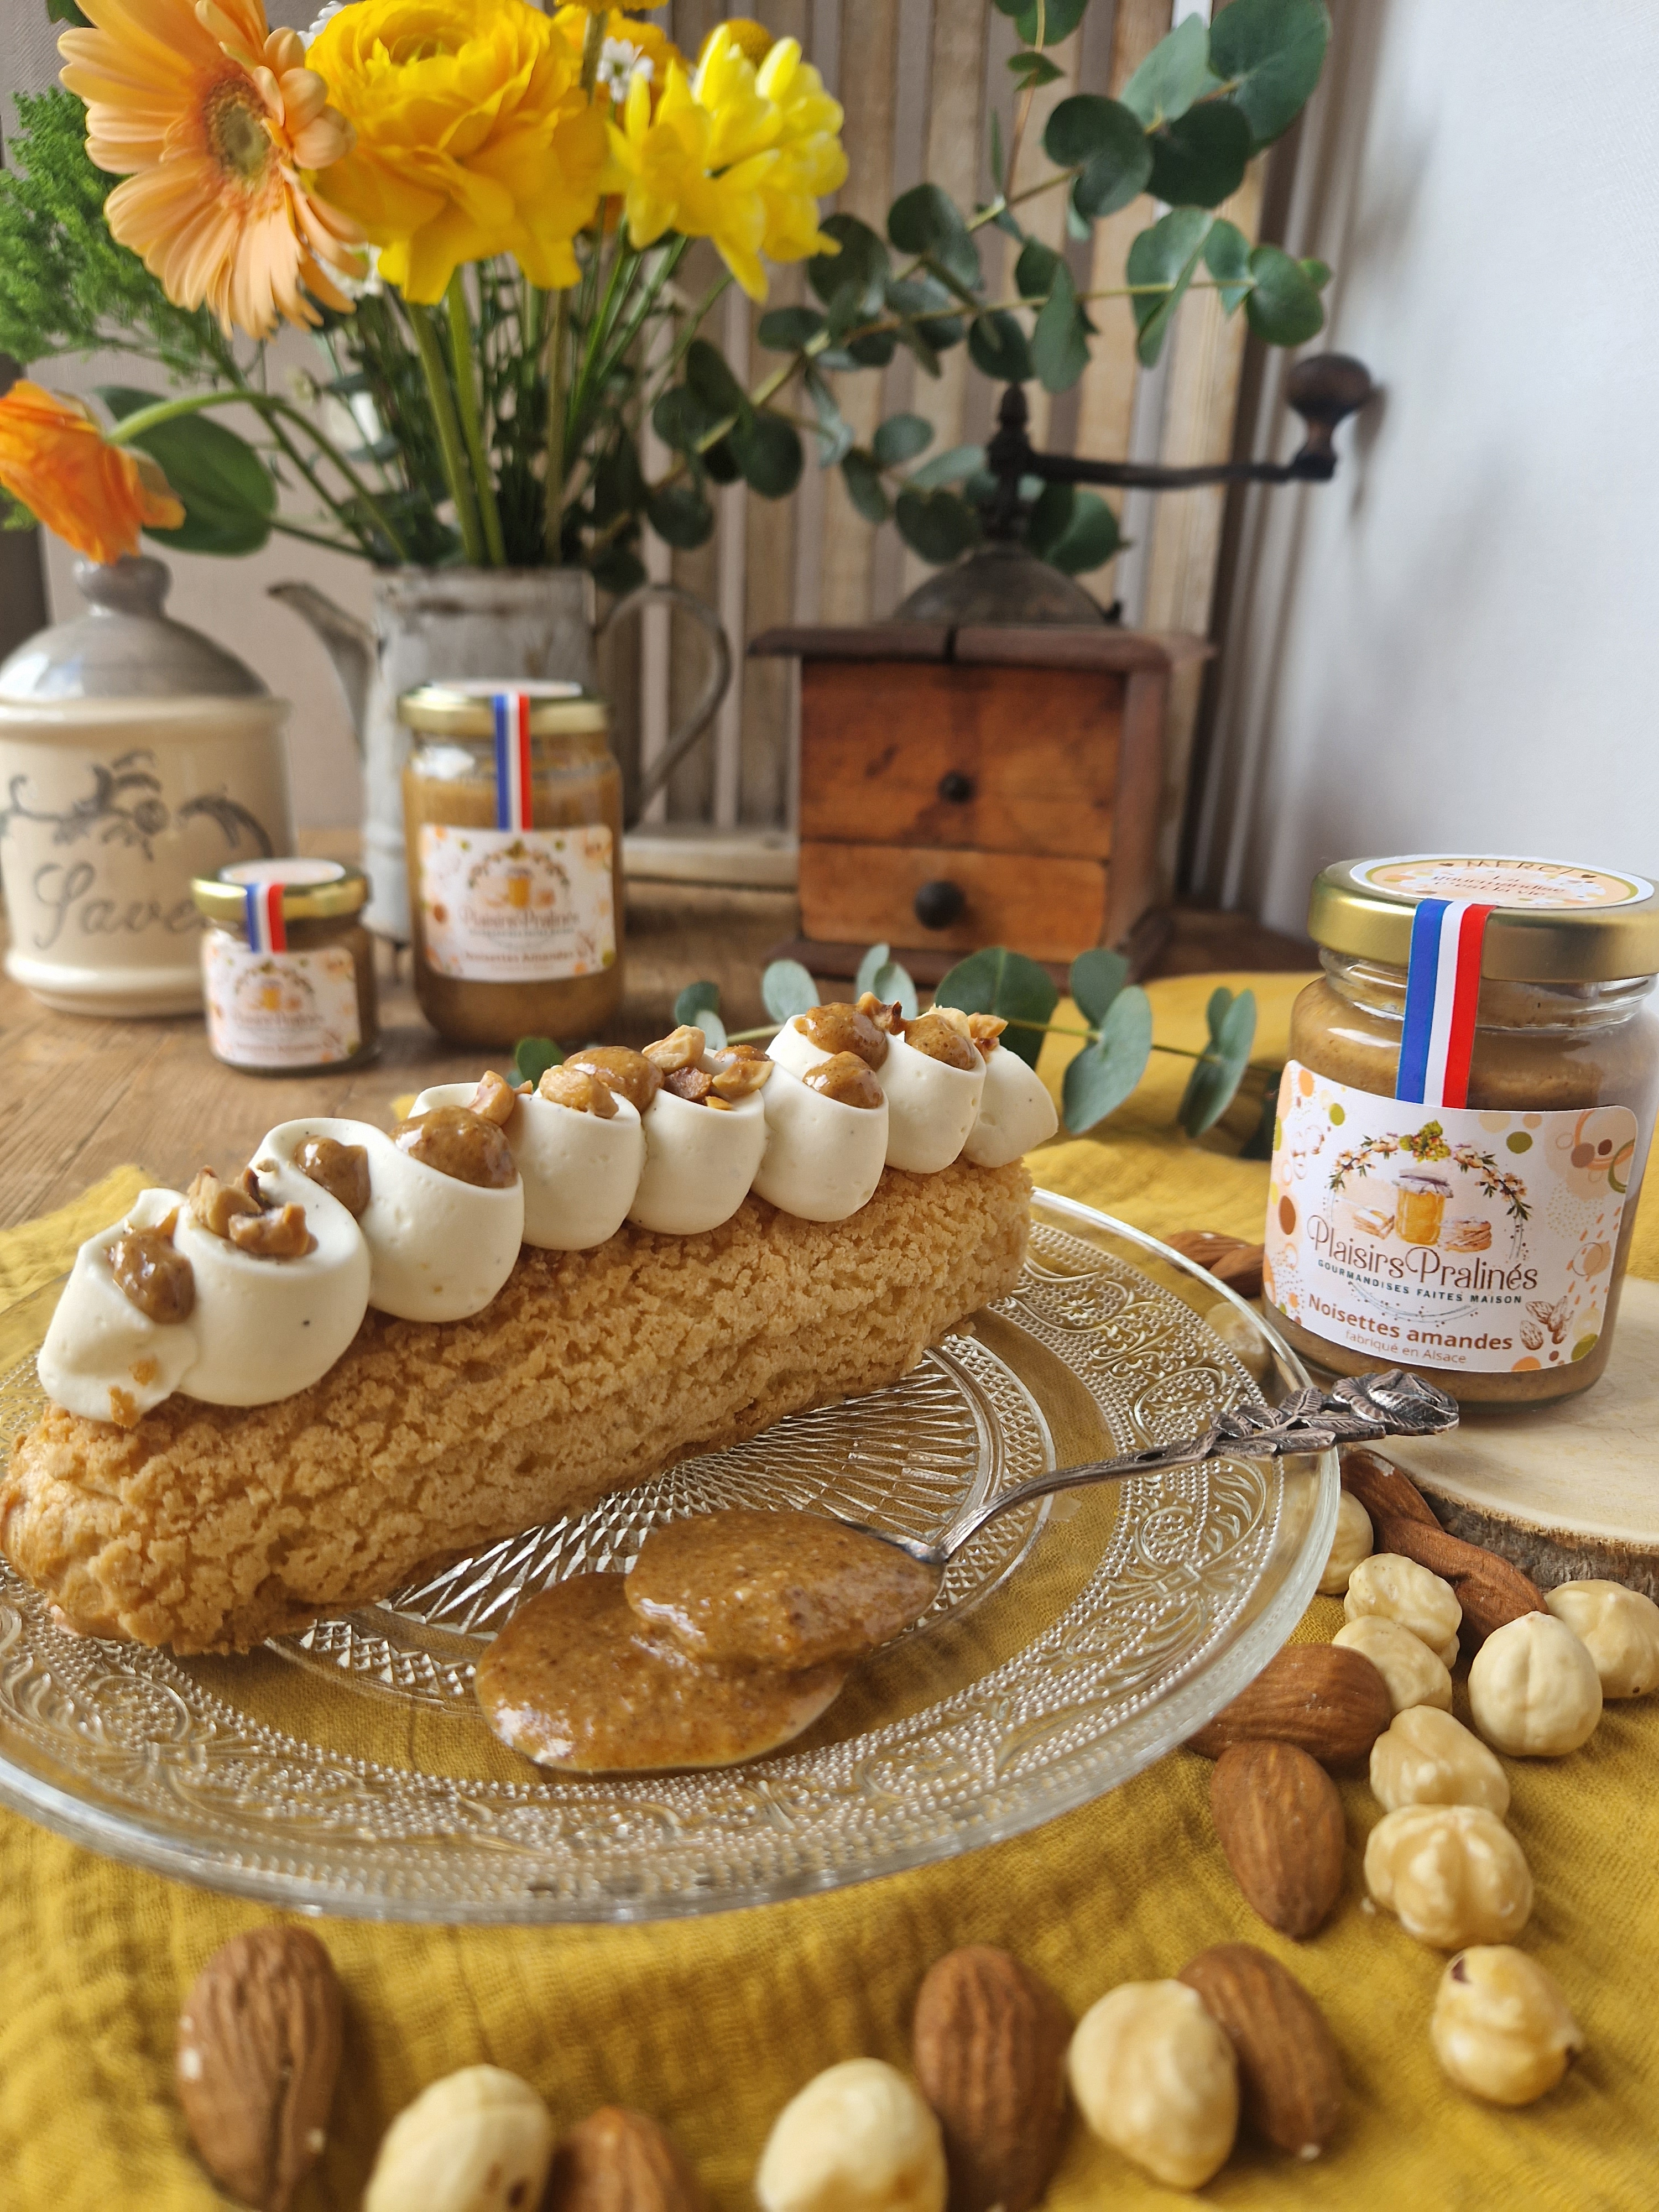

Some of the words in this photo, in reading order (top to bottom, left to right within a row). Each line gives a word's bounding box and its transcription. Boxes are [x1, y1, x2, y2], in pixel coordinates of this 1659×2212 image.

[1467, 859, 1575, 874] MERCI
[1307, 1215, 1404, 1279] Plaisirs
[1405, 1246, 1538, 1290] Pralinés
[1318, 1259, 1410, 1294] GOURMANDISES
[1417, 1288, 1463, 1302] FAITES
[1470, 1295, 1522, 1303] MAISON
[1309, 1293, 1400, 1338] Noisettes
[1406, 1328, 1513, 1350] amandes
[1345, 1329, 1399, 1353] fabriqué
[1402, 1347, 1419, 1357] en
[1422, 1349, 1467, 1363] Alsace
